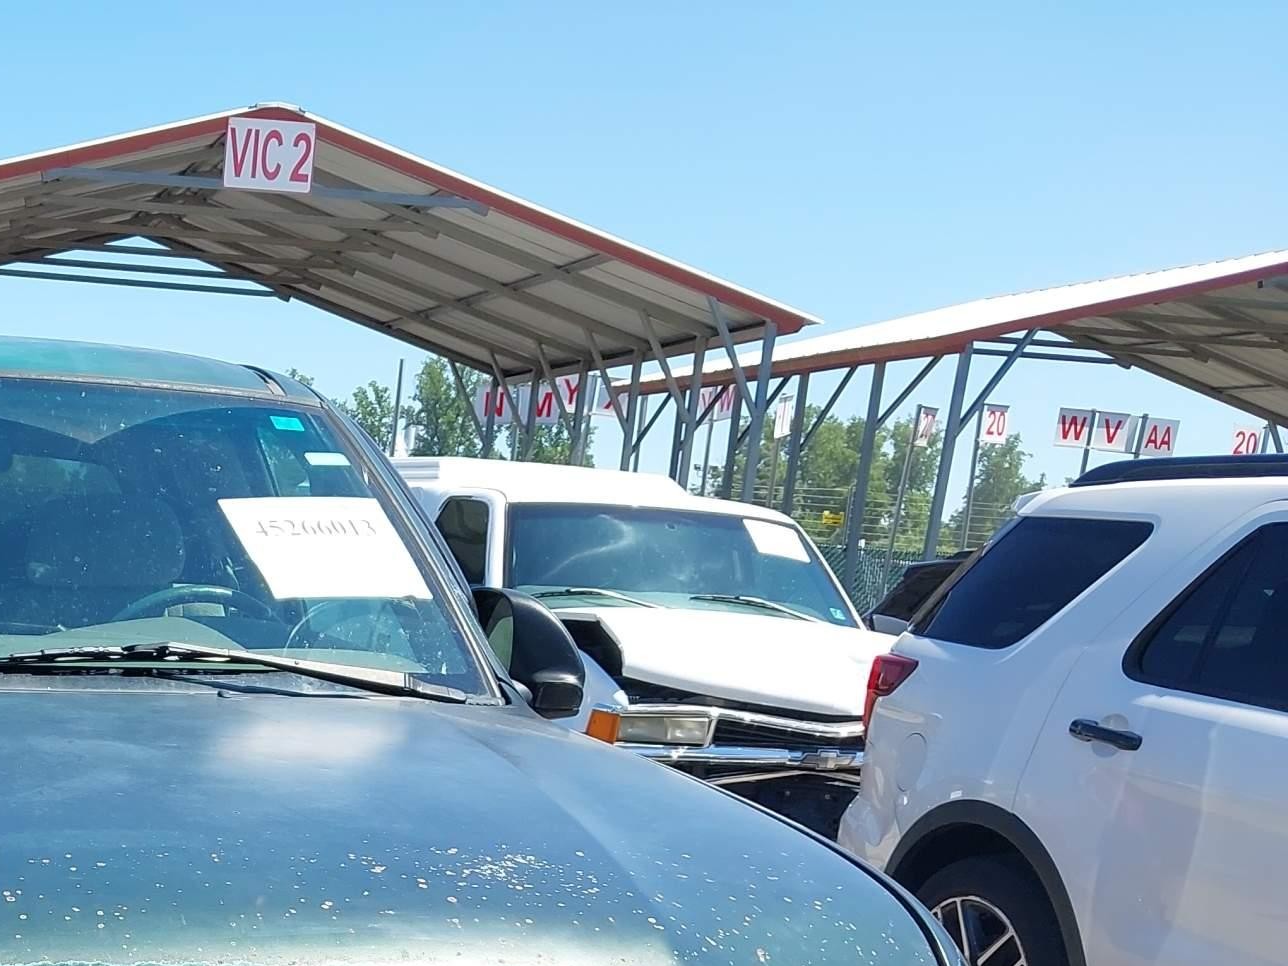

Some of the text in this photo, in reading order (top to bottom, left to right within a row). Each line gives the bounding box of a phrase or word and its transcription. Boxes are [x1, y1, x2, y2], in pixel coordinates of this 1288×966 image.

[230, 127, 312, 183] VIC 2
[985, 411, 1006, 436] 20
[1061, 415, 1087, 441] W
[1104, 418, 1123, 444] V
[1144, 425, 1172, 451] AA
[1232, 431, 1258, 454] 20
[255, 519, 376, 536] 45266013
